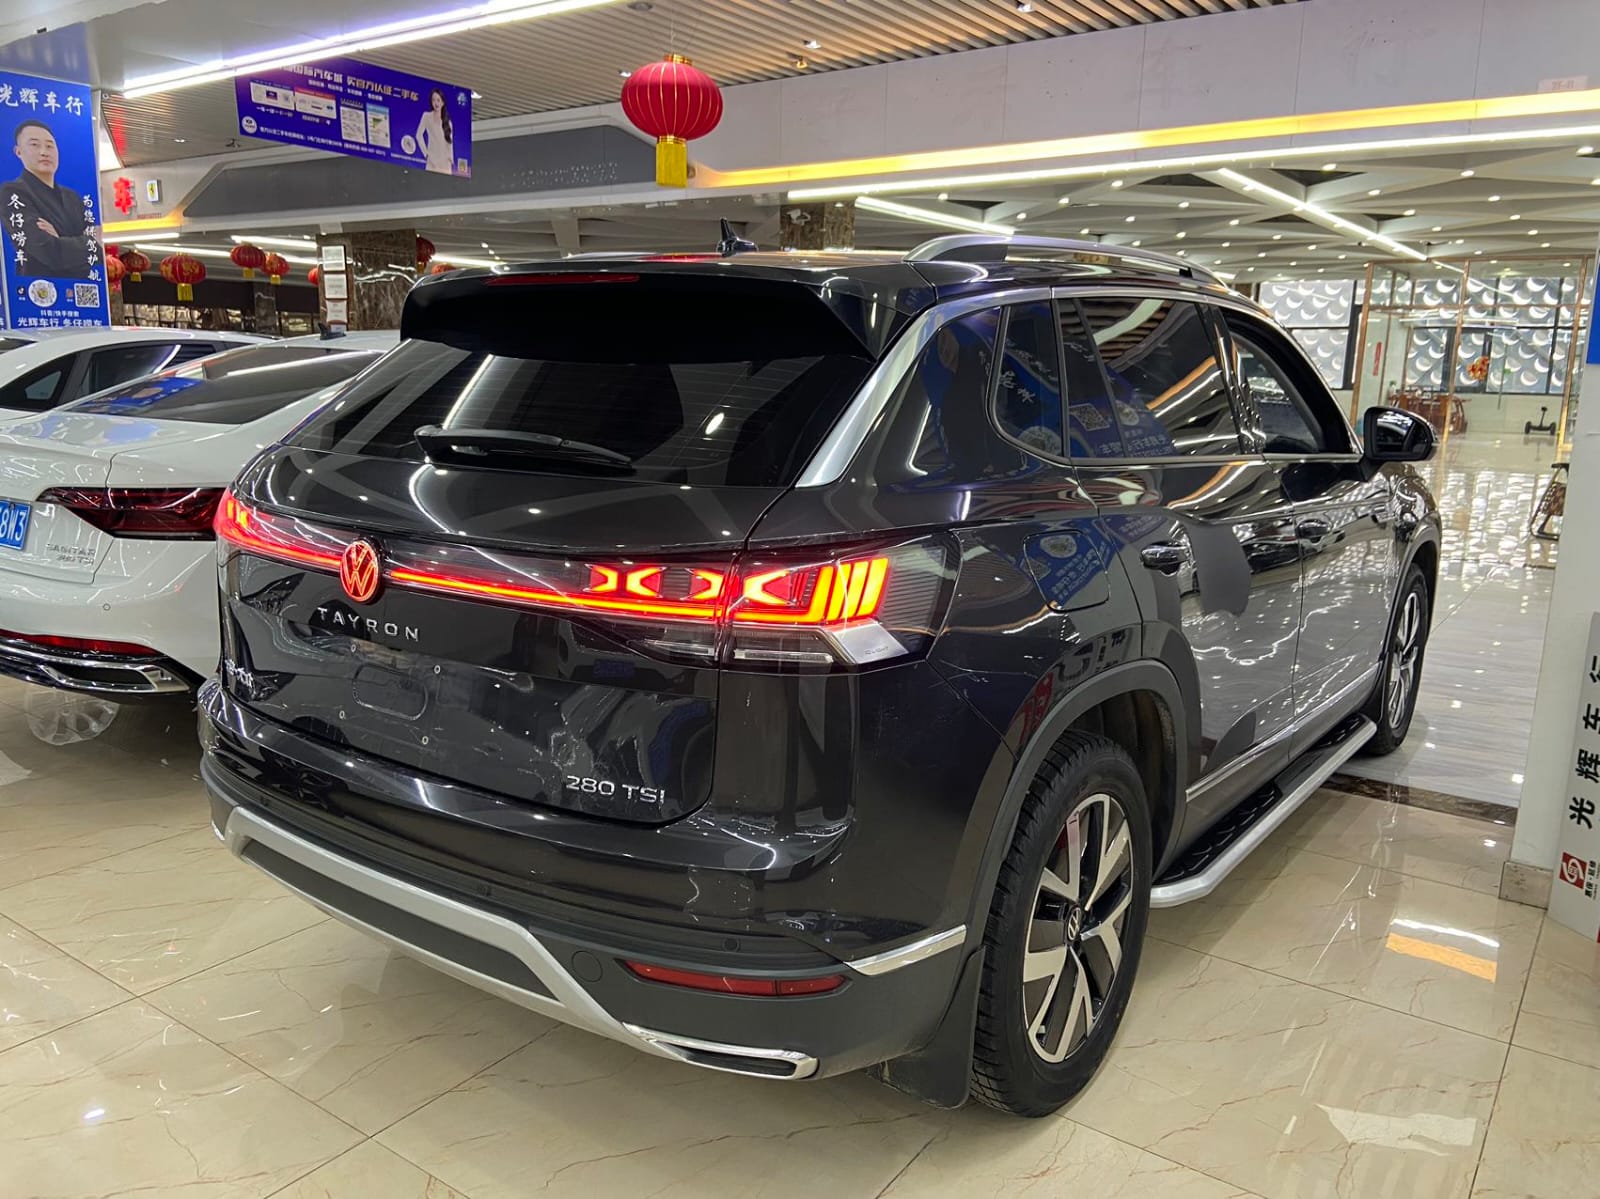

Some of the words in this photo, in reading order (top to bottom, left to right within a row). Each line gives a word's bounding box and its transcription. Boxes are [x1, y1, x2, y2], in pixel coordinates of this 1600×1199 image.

[0, 83, 84, 116] 光辉车行
[8, 193, 28, 266] 冬仔唠车
[83, 193, 102, 282] 为您保驾护航
[0, 508, 26, 541] 8W3
[317, 606, 420, 642] TAYRON
[566, 775, 615, 796] 280
[621, 783, 666, 804] TSI
